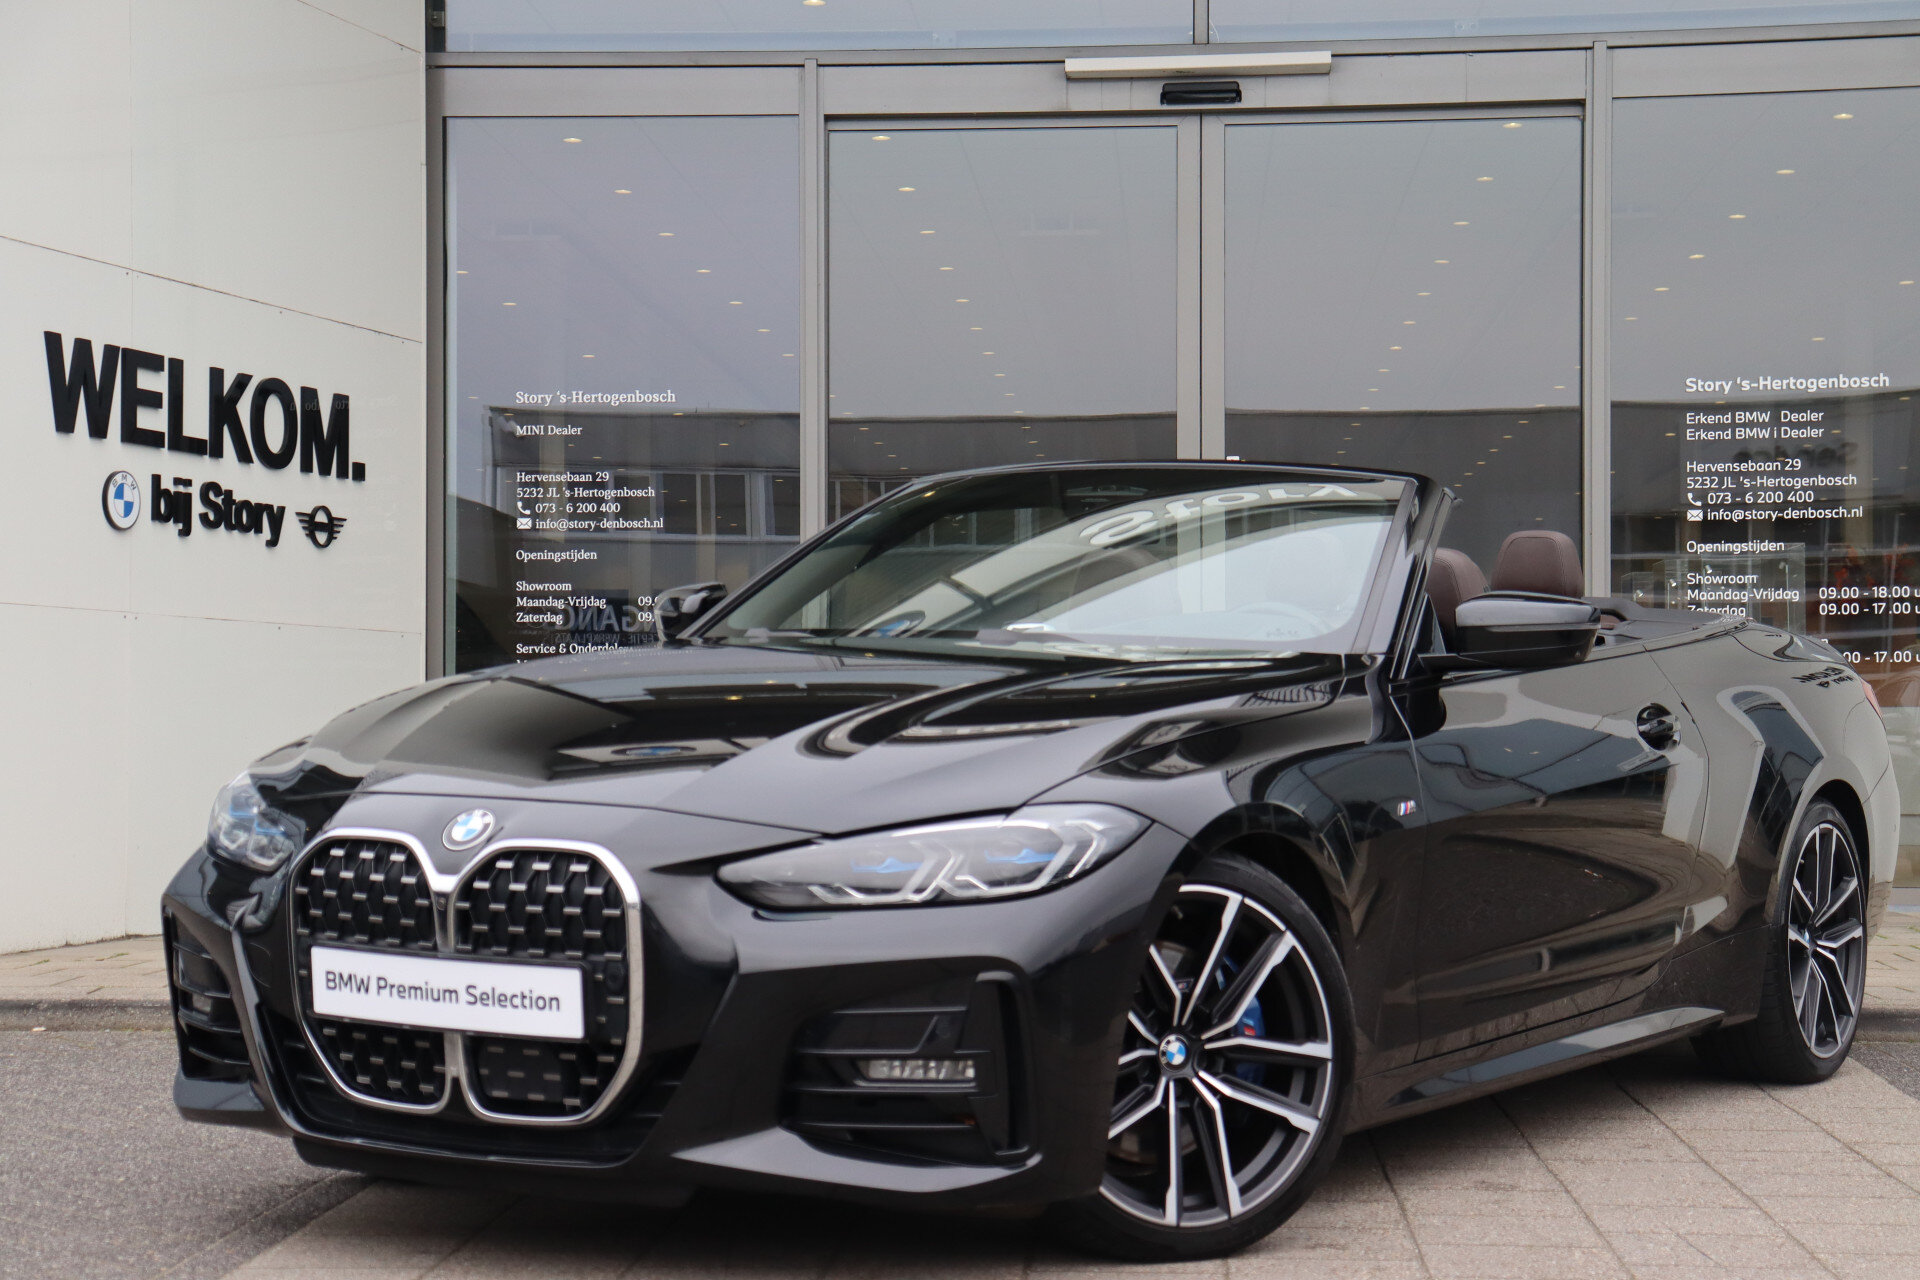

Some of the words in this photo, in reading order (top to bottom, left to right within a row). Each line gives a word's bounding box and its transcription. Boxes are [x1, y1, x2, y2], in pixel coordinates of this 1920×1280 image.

[1686, 378, 1732, 394] Story
[44, 331, 366, 480] WELKOM.
[516, 392, 552, 406] Story
[1687, 412, 1731, 424] Erkend
[1736, 411, 1770, 423] BMW
[1781, 410, 1824, 422] Dealer
[517, 425, 544, 435] MINI
[548, 425, 582, 435] Dealer
[1687, 428, 1731, 440] Erkend
[1736, 427, 1770, 439] BMW
[1774, 427, 1777, 438] i
[1781, 426, 1824, 438] Dealer
[1687, 458, 1782, 472] Hervensebaan
[1785, 459, 1801, 470] 29
[517, 472, 592, 482] Hervensebaan
[596, 471, 609, 481] 29
[1687, 477, 1718, 488] 5232
[1722, 477, 1736, 489] JL
[517, 488, 543, 497] 5232
[547, 488, 560, 497] JL
[1708, 492, 1731, 504] 073
[1745, 492, 1753, 503] 6
[1757, 491, 1783, 503] 200
[1787, 491, 1814, 502] 400
[151, 474, 192, 537] bij
[199, 481, 286, 547] Story
[536, 503, 554, 513] 073
[566, 503, 573, 512] 6
[577, 503, 597, 512] 200
[600, 502, 620, 512] 400
[1708, 506, 1863, 522] info@story-denbosch.nl
[536, 518, 663, 530] info@story-denbosch.nl
[1687, 541, 1785, 554] Openingstijden
[516, 549, 597, 562] Openingstijden
[1687, 571, 1758, 585] Showroom
[516, 581, 572, 591] Showroom
[1687, 588, 1800, 602] Maandag-Vrijdag
[1819, 587, 1860, 599] 09.00
[1872, 586, 1910, 598] 18.00
[516, 596, 606, 609] Maandag-Vrijdag
[1819, 603, 1859, 615] 09.00
[516, 612, 563, 624] Zaterdag
[516, 644, 556, 653] Service
[559, 643, 566, 653] &
[325, 971, 371, 995] BMW
[376, 978, 459, 1004] Premium
[466, 985, 561, 1012] Selection
